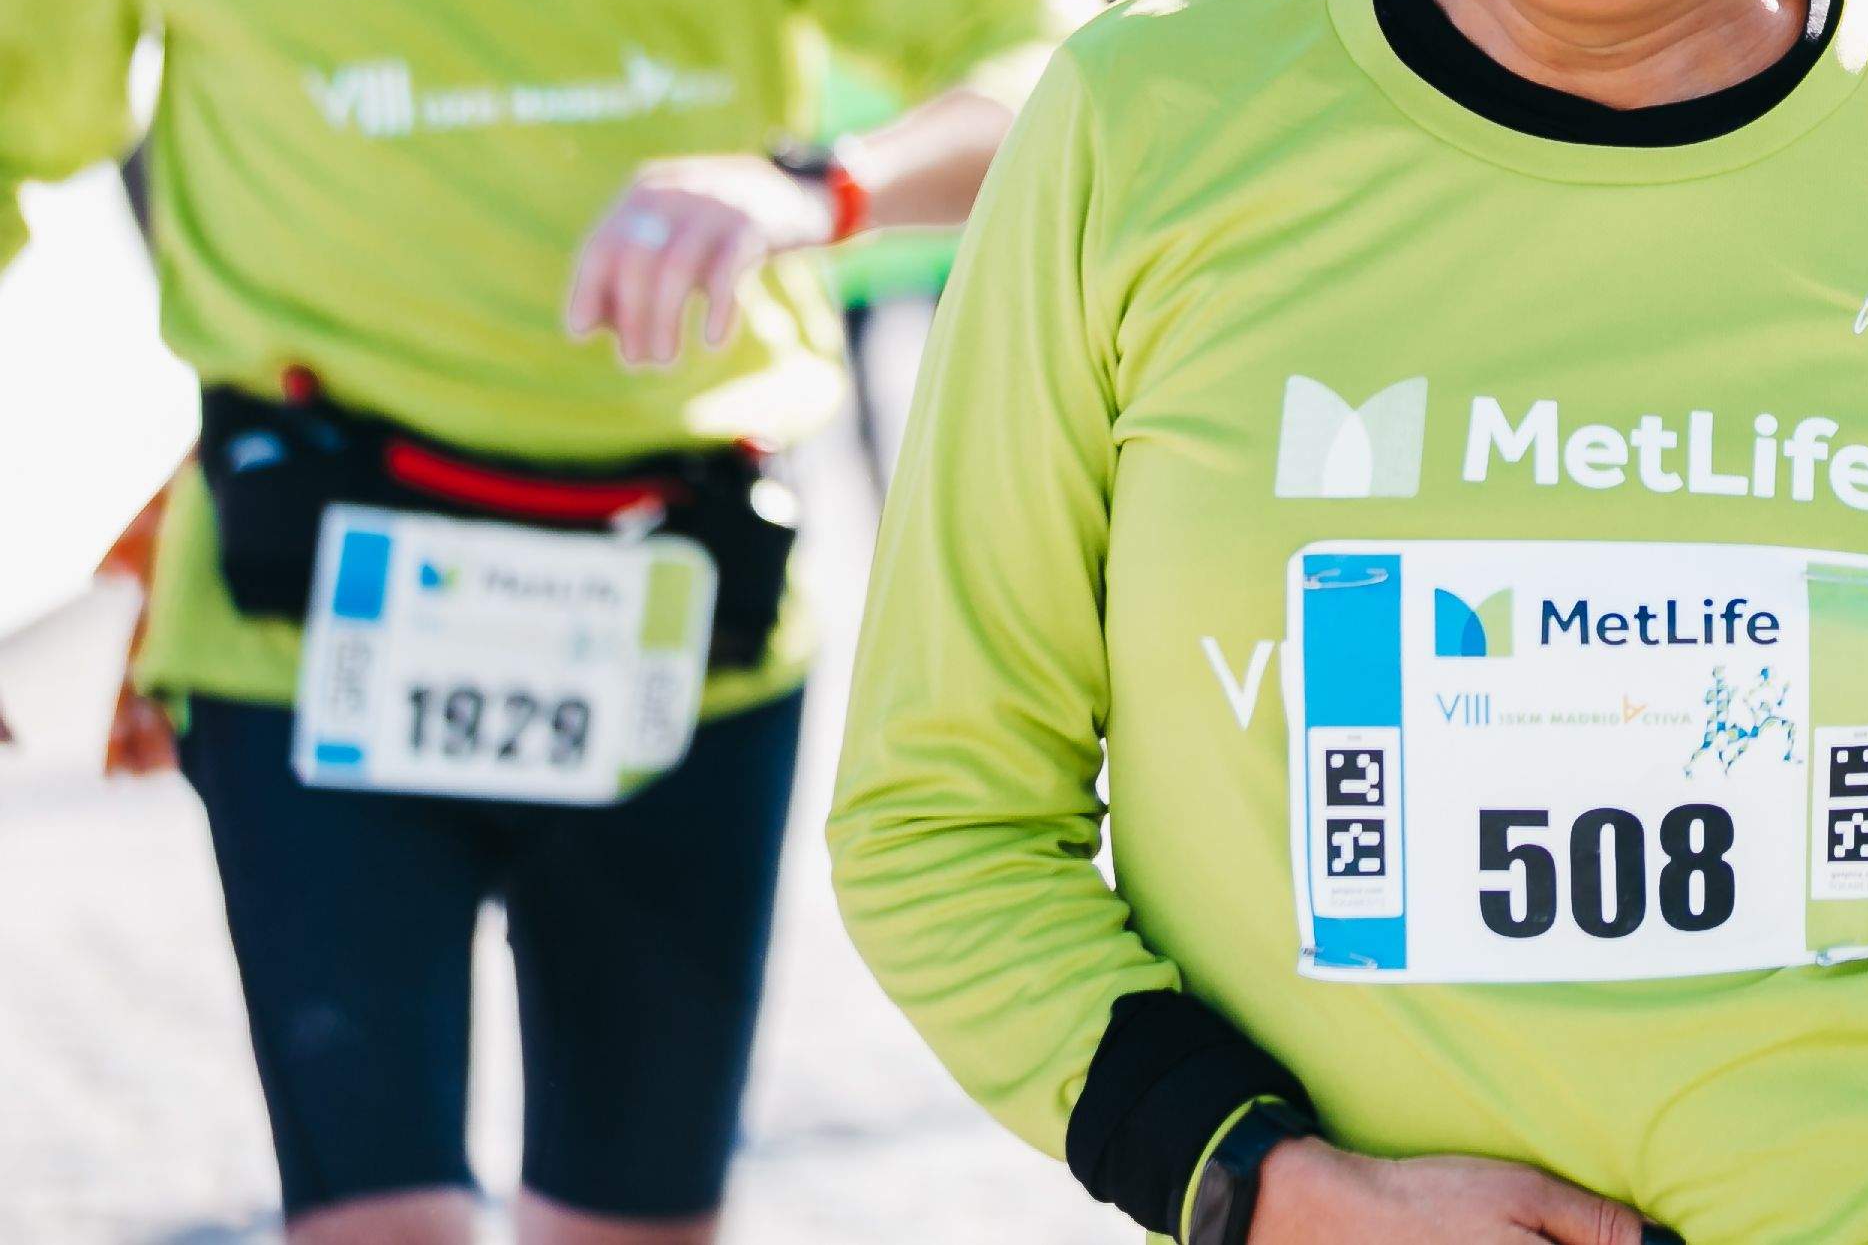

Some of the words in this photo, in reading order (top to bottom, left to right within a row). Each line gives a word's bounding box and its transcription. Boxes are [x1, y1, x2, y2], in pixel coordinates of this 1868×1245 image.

[1539, 597, 1780, 647] MetLife
[406, 684, 594, 766] 1929
[1435, 692, 1491, 725] VIII
[1477, 802, 1737, 939] 508
